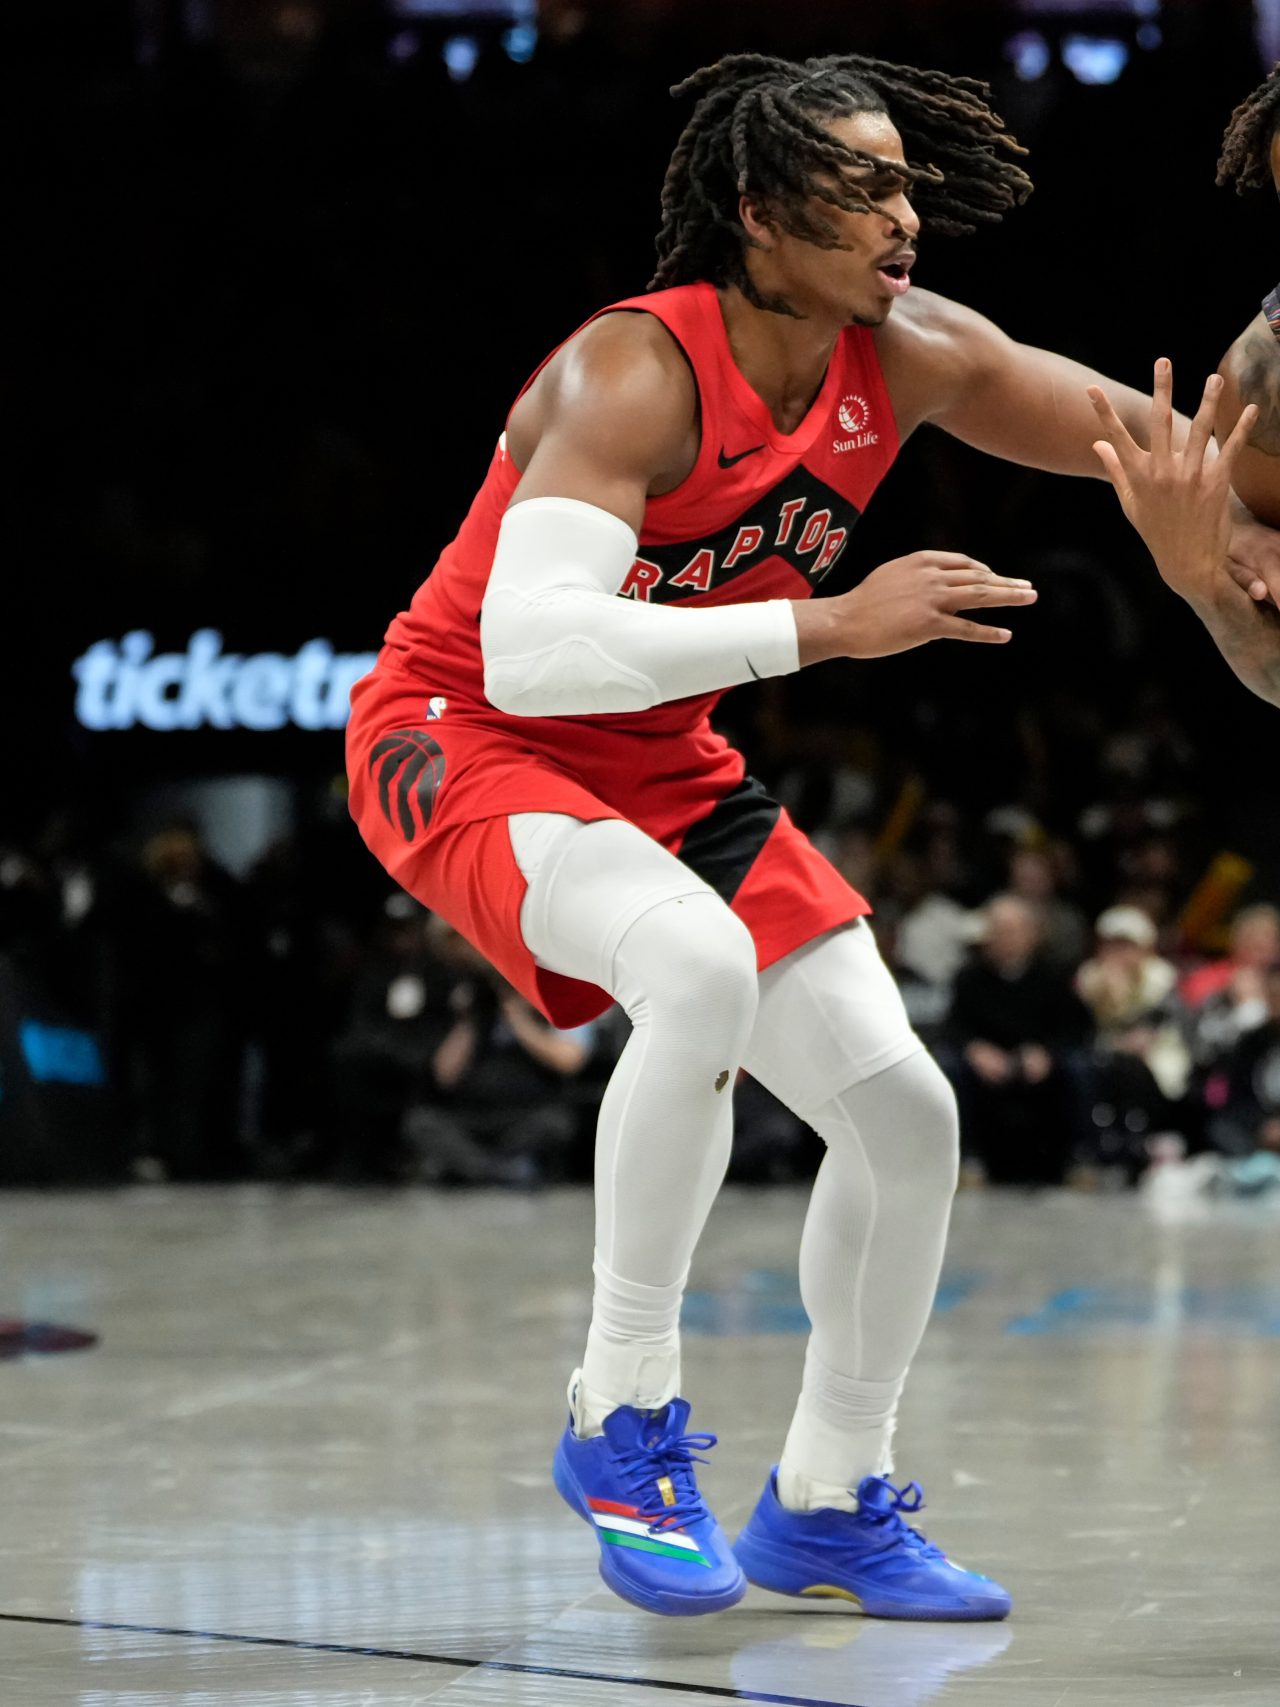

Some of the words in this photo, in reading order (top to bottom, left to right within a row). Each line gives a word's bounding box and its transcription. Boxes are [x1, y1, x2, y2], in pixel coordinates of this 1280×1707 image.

[832, 439, 856, 454] Sun
[857, 430, 879, 448] Life
[618, 497, 848, 604] RAPTOR
